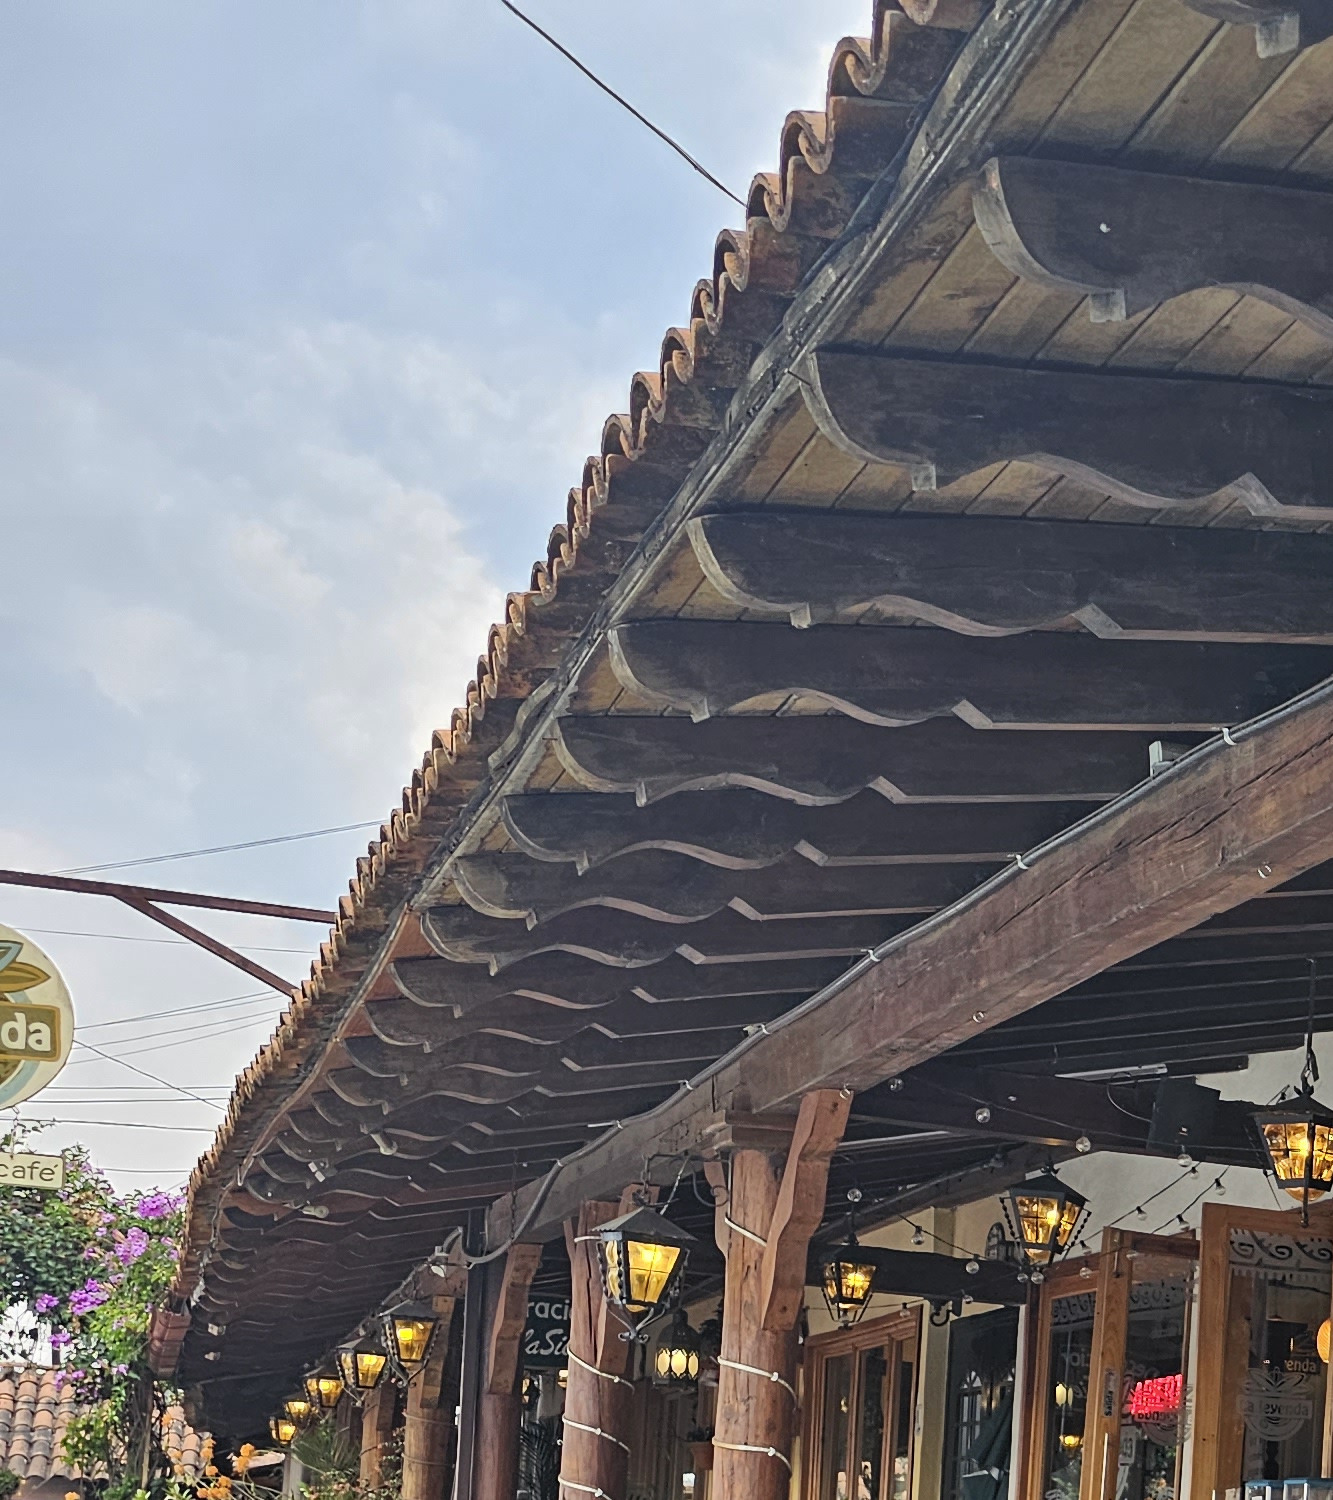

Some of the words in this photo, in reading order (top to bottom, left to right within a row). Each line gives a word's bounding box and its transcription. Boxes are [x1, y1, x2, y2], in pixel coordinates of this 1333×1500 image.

[1, 1012, 51, 1052] da
[526, 1299, 572, 1321] raci
[1284, 1357, 1317, 1373] enda
